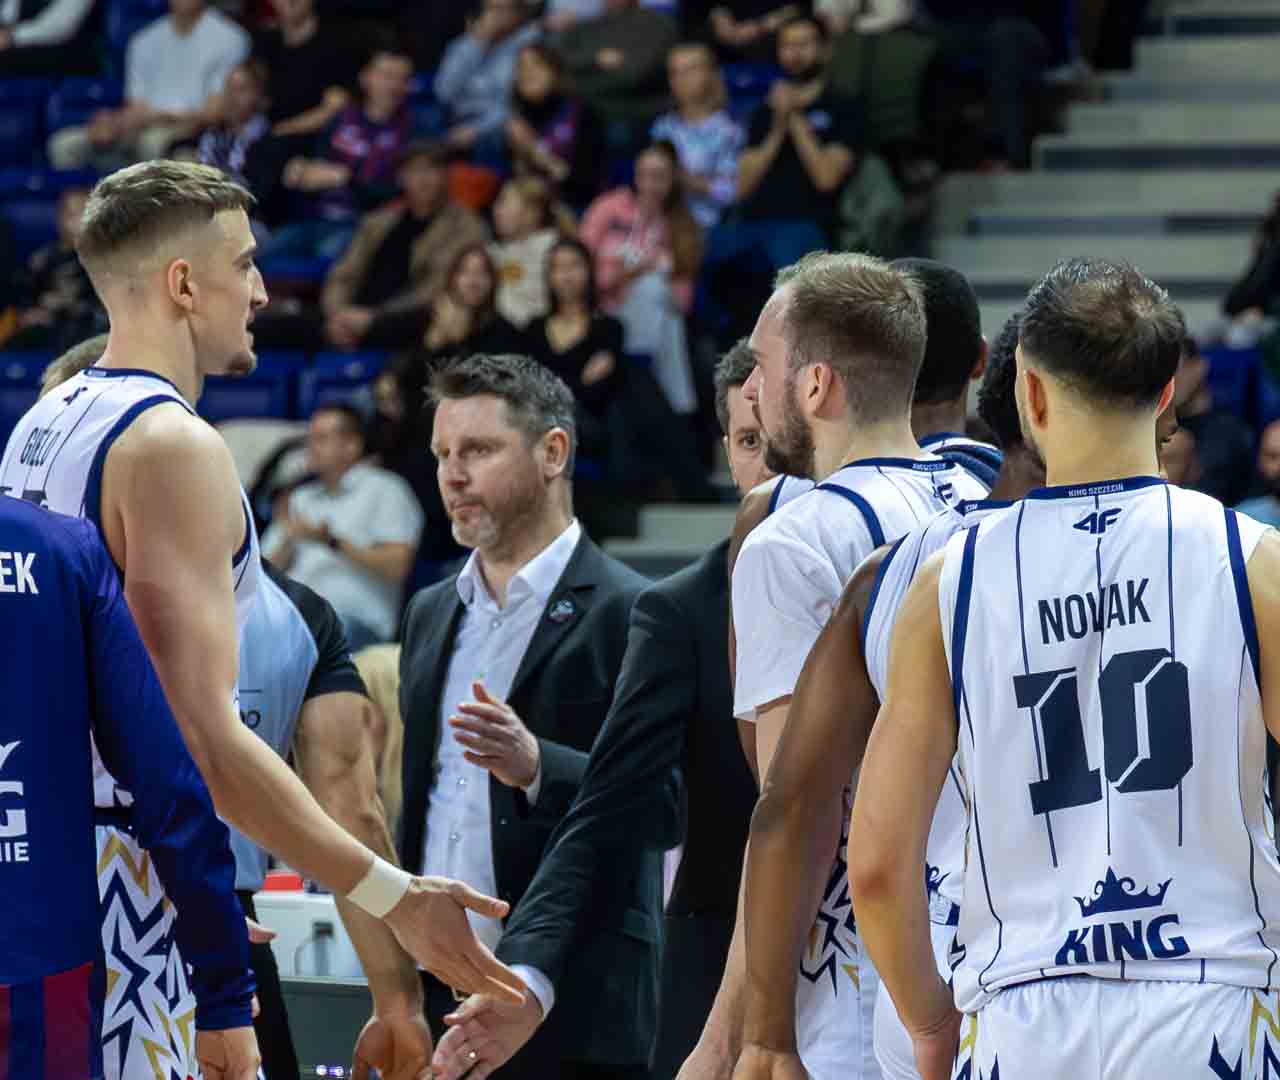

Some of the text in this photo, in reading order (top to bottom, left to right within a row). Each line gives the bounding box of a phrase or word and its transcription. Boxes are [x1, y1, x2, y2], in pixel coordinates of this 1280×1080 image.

[1072, 508, 1122, 534] 4F
[1037, 577, 1151, 645] NOVAK
[1012, 647, 1194, 816] 10
[1055, 913, 1191, 966] KING
